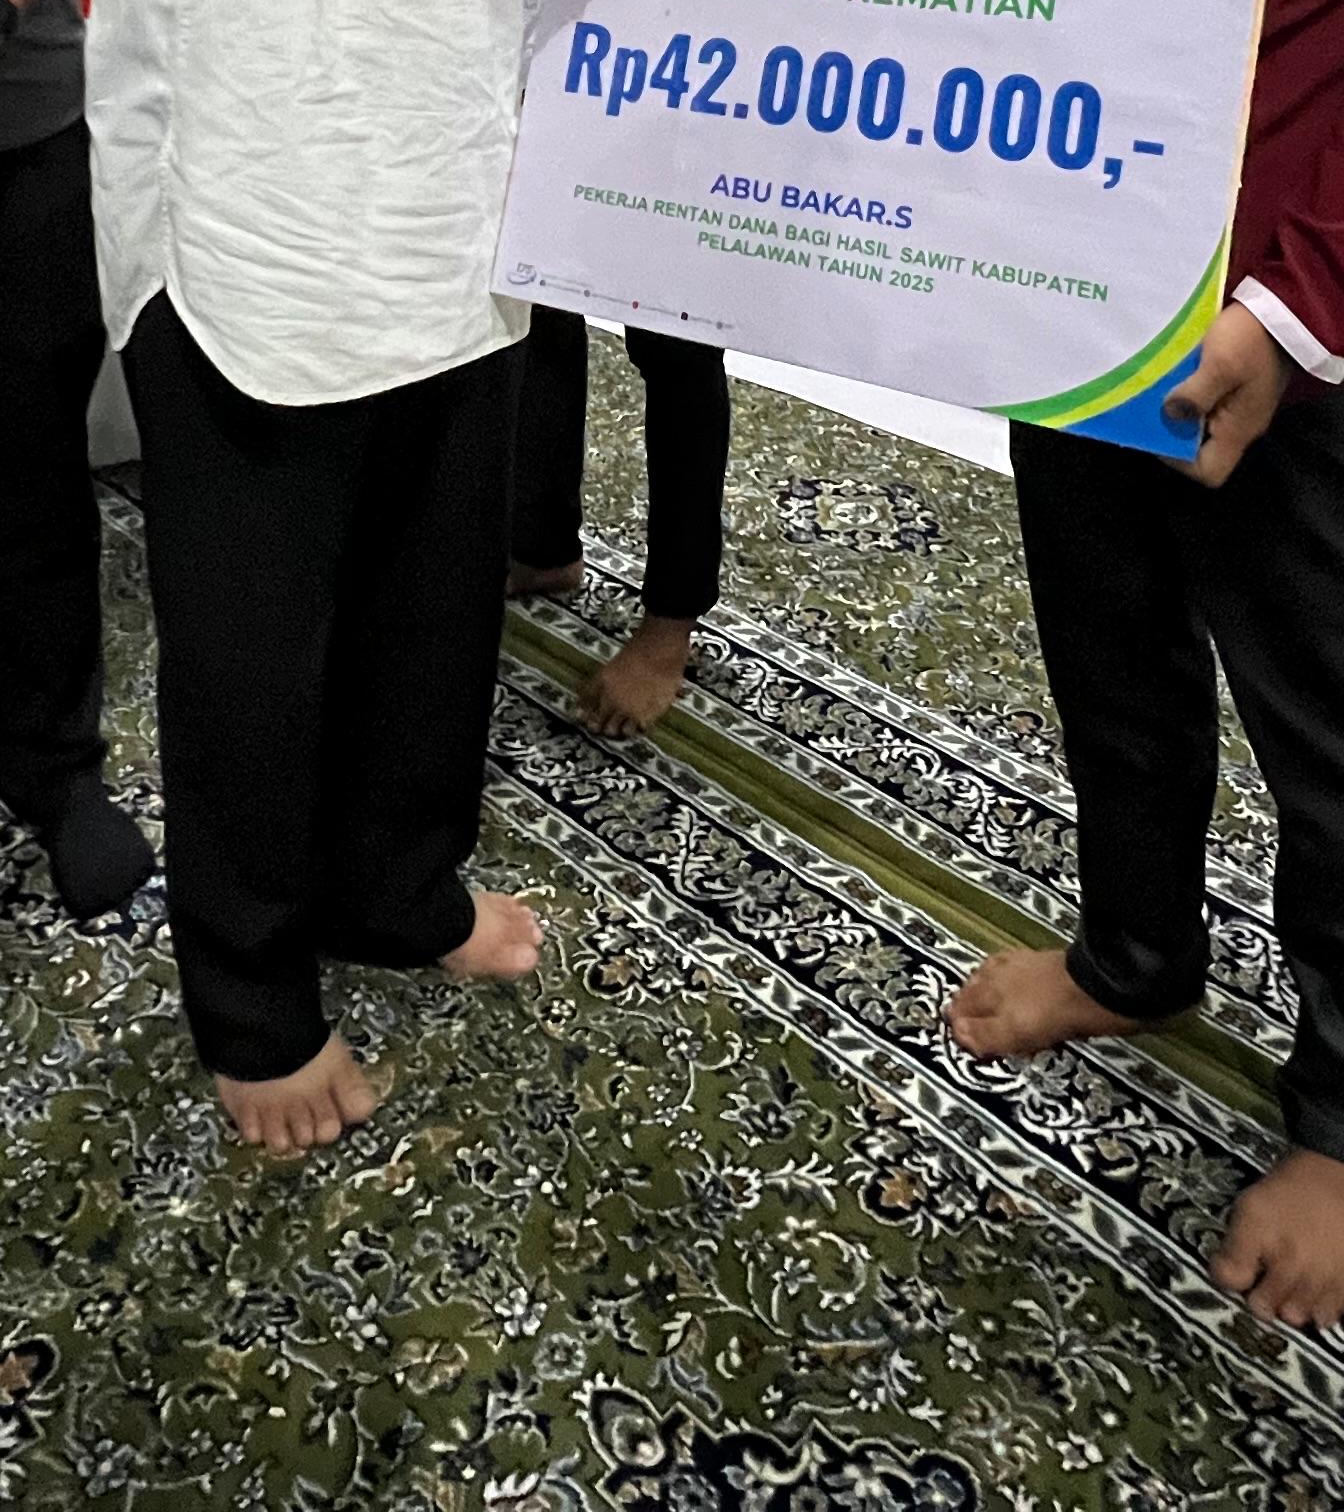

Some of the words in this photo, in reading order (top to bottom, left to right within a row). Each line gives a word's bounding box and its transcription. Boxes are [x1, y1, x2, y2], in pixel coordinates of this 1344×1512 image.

[564, 21, 1165, 188] Rp42.000.000,-
[573, 184, 650, 212] PEKERJA
[653, 198, 723, 227] RENTAN
[728, 211, 779, 237] DANA
[785, 222, 832, 250] BAGI
[837, 232, 893, 261] HASIL
[899, 244, 967, 275] SAWIT
[971, 260, 1109, 303] KABUPATEN
[710, 174, 773, 204] ABU
[780, 185, 914, 230] BAKAR.S
[697, 231, 812, 271] PELALAWAN
[817, 253, 884, 282] TAHUN
[889, 267, 935, 293] 2025
